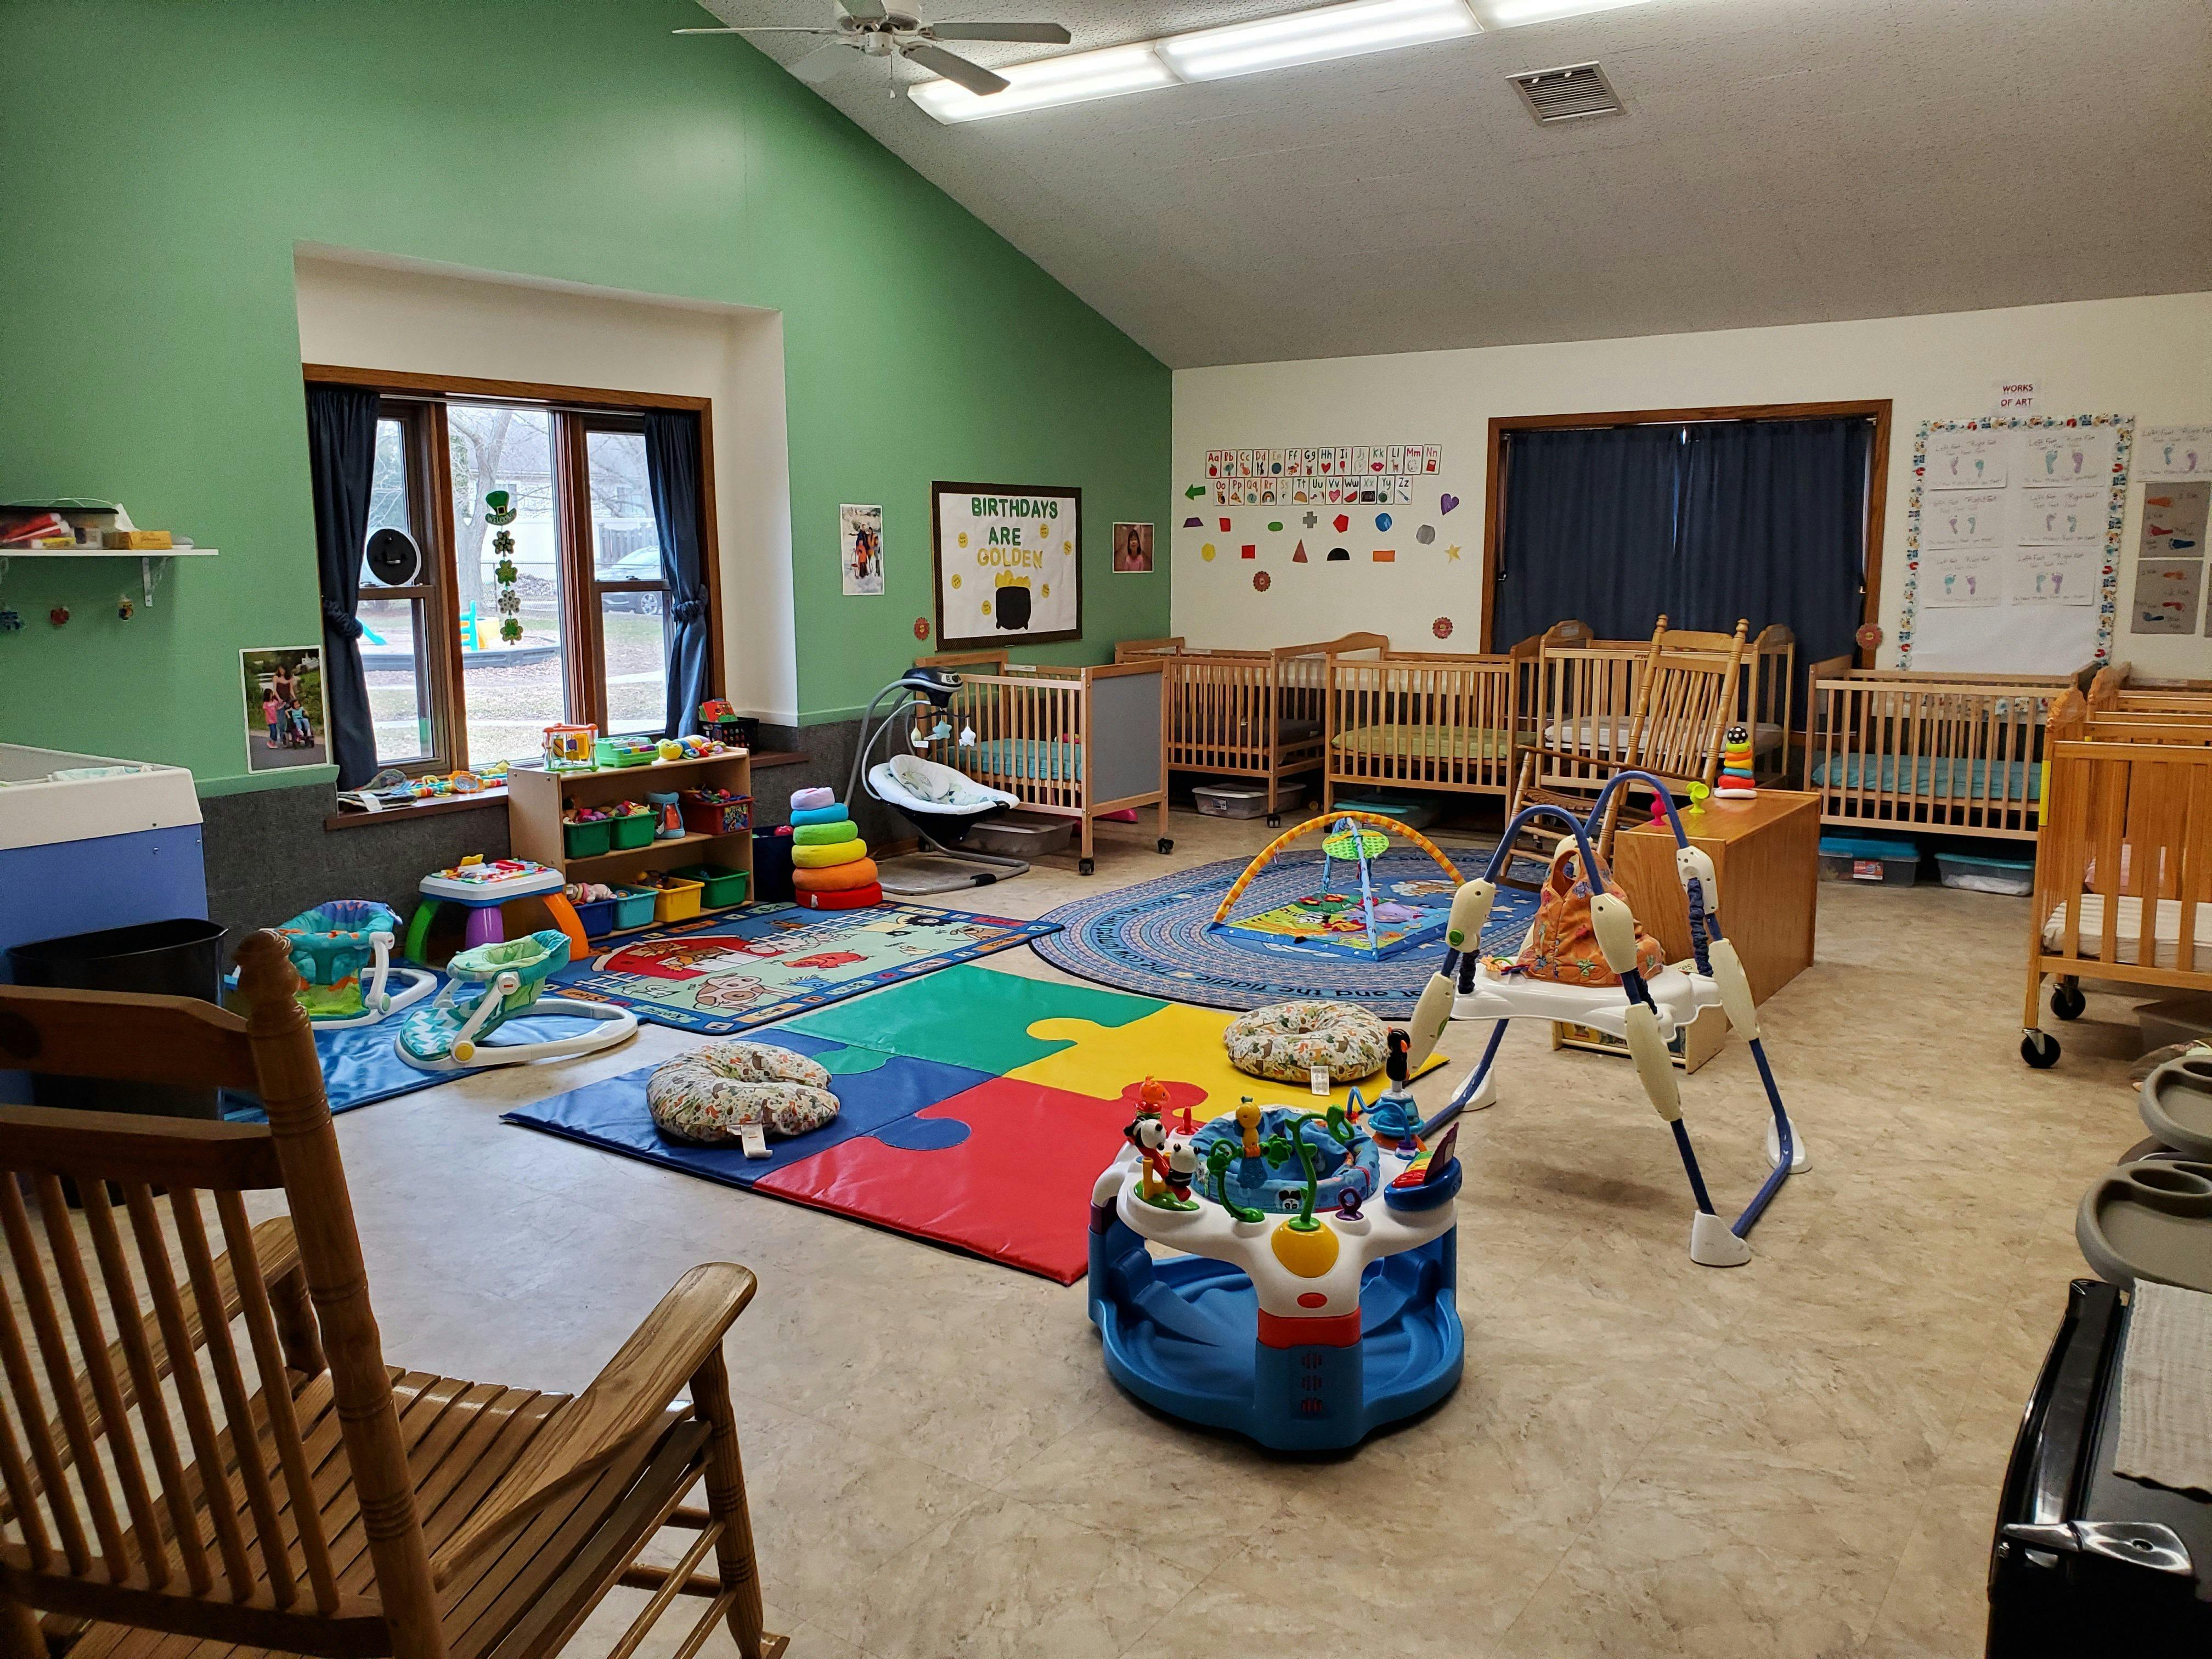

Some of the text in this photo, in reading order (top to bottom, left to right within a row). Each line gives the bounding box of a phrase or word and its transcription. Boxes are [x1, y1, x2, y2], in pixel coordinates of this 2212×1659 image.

[2015, 398, 2034, 406] ART
[1208, 453, 1219, 462] Aa
[1224, 452, 1234, 461] Bb
[1240, 452, 1250, 461] Cc
[1256, 451, 1266, 461] Dd
[1289, 450, 1298, 460] Ff
[1304, 450, 1316, 461] Gg
[1321, 449, 1332, 459] Hh
[1340, 449, 1348, 459] Ii
[1373, 448, 1384, 458] Kk
[1392, 447, 1400, 458] Ll
[1407, 448, 1421, 458] Mm
[1426, 447, 1437, 457] Nn
[1216, 481, 1226, 490] Oo
[1233, 480, 1242, 492] Pp
[1247, 480, 1258, 492] Qq
[1265, 480, 1273, 489] Rr
[1297, 479, 1306, 488] Tt
[1312, 479, 1323, 488] Uu
[1329, 479, 1340, 488] Vv
[1345, 478, 1359, 488] Ww
[1363, 478, 1374, 488] Xx
[1382, 478, 1391, 490] Yy
[1399, 477, 1409, 488] Zz
[972, 496, 1058, 519] BIRTHDAYS
[989, 526, 1022, 546] ARE
[978, 548, 1043, 569] GOLDEN
[1092, 896, 1180, 974] The cow jumped over the moon
[1195, 975, 1266, 992] fiddle
[1279, 986, 1322, 996] the
